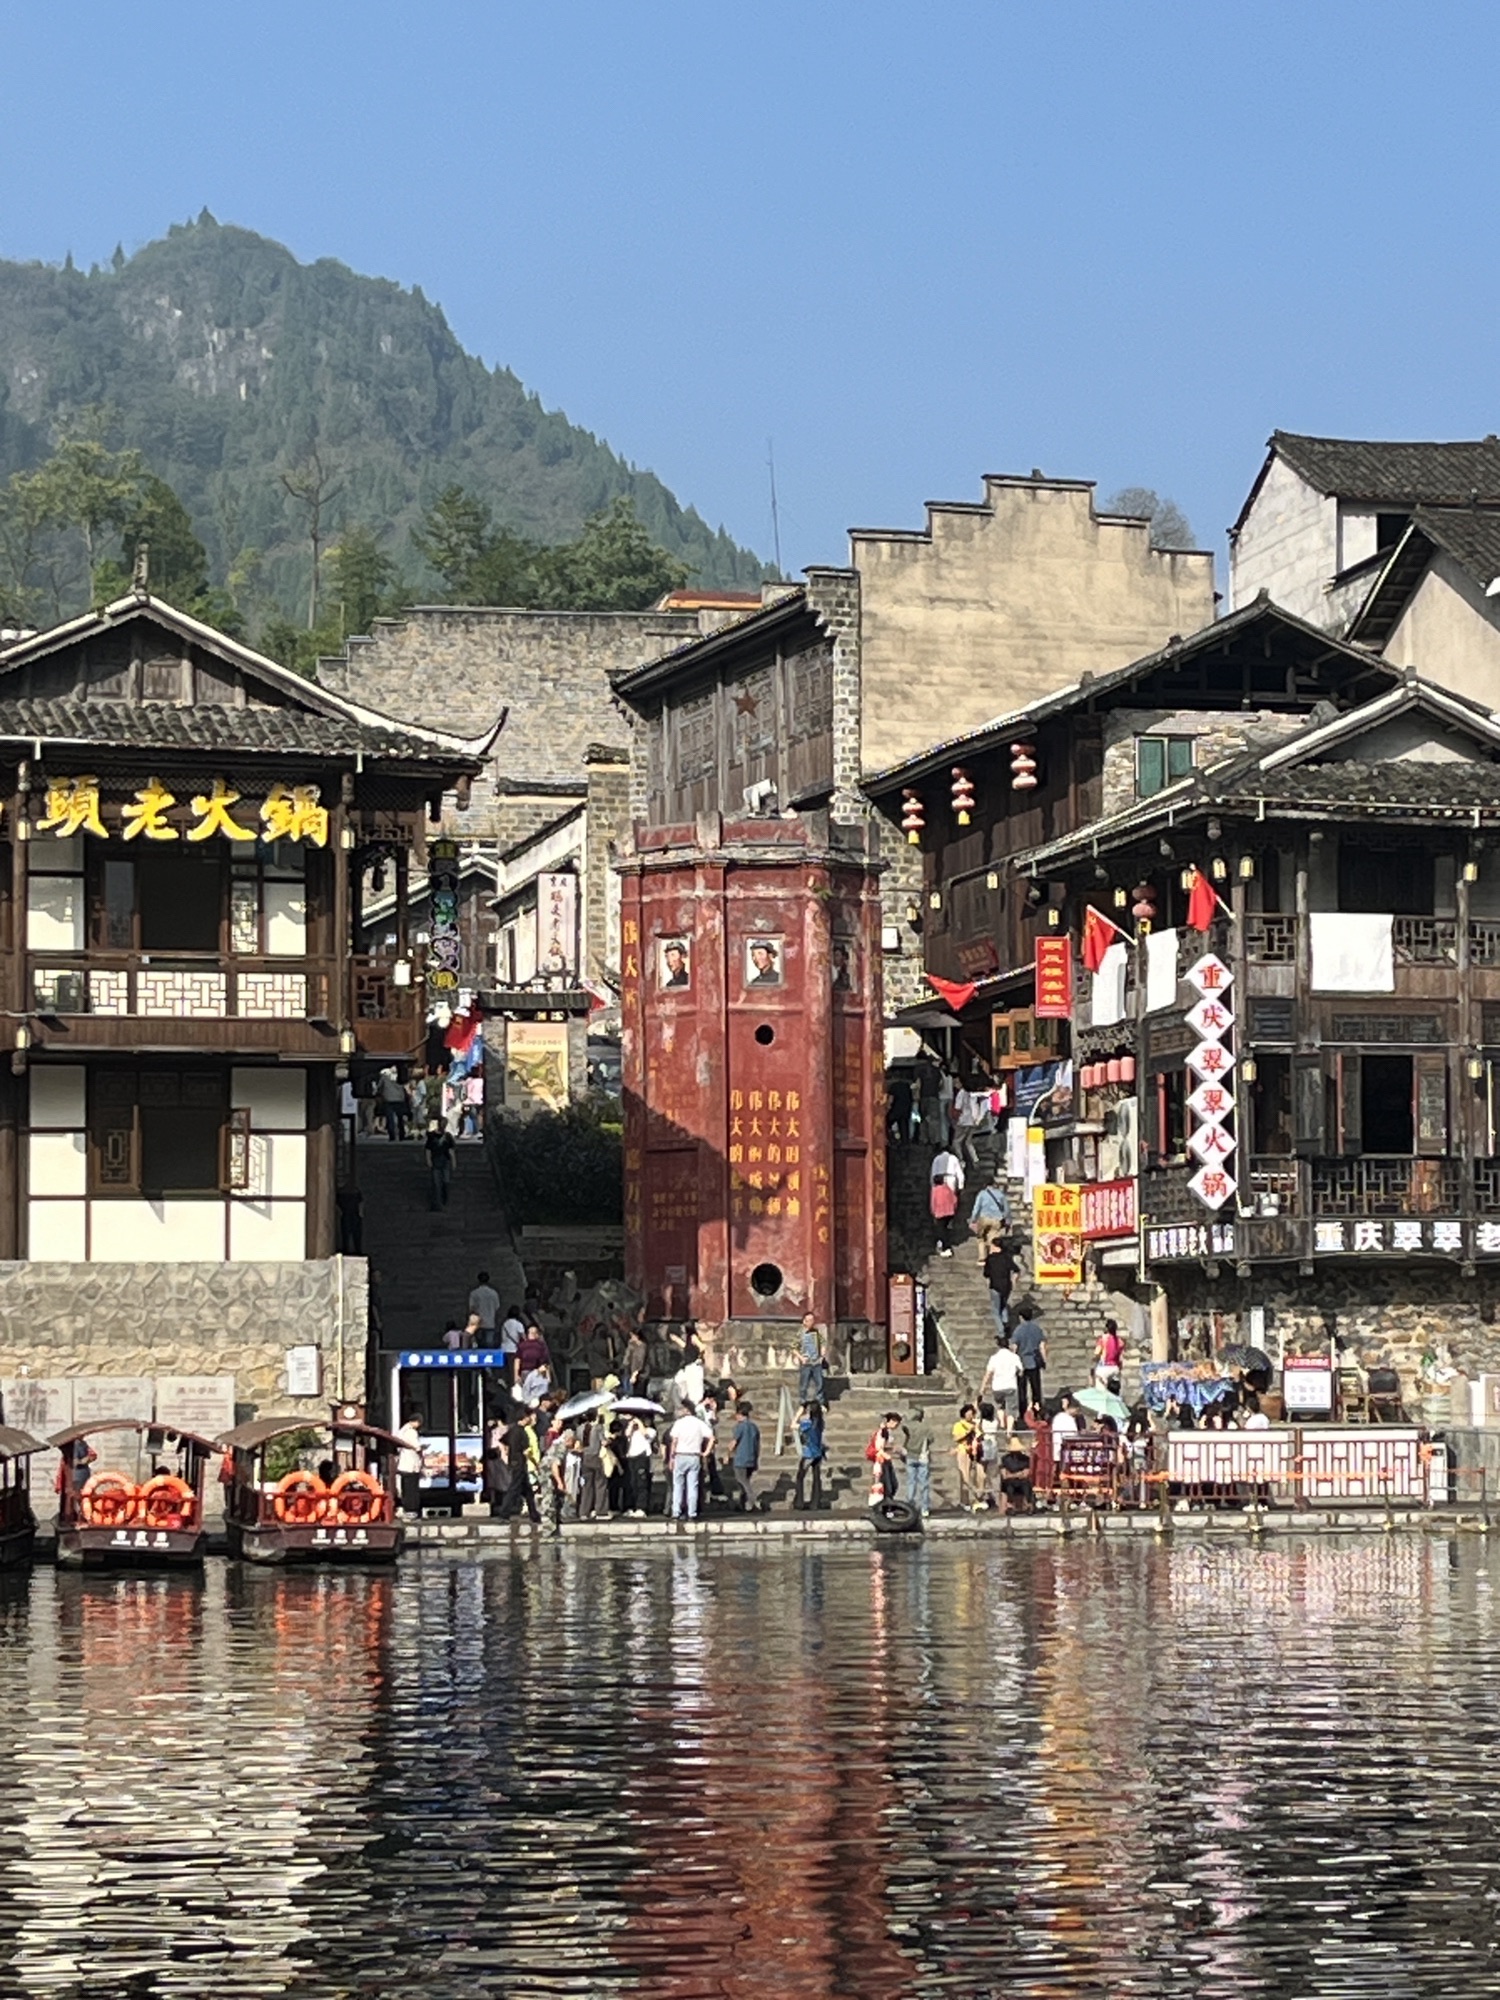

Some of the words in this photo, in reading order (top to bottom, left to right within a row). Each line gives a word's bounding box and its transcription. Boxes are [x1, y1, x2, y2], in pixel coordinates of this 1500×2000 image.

[1198, 963, 1228, 1198] 重庆翠翠火锅
[1042, 1189, 1074, 1205] 重庆
